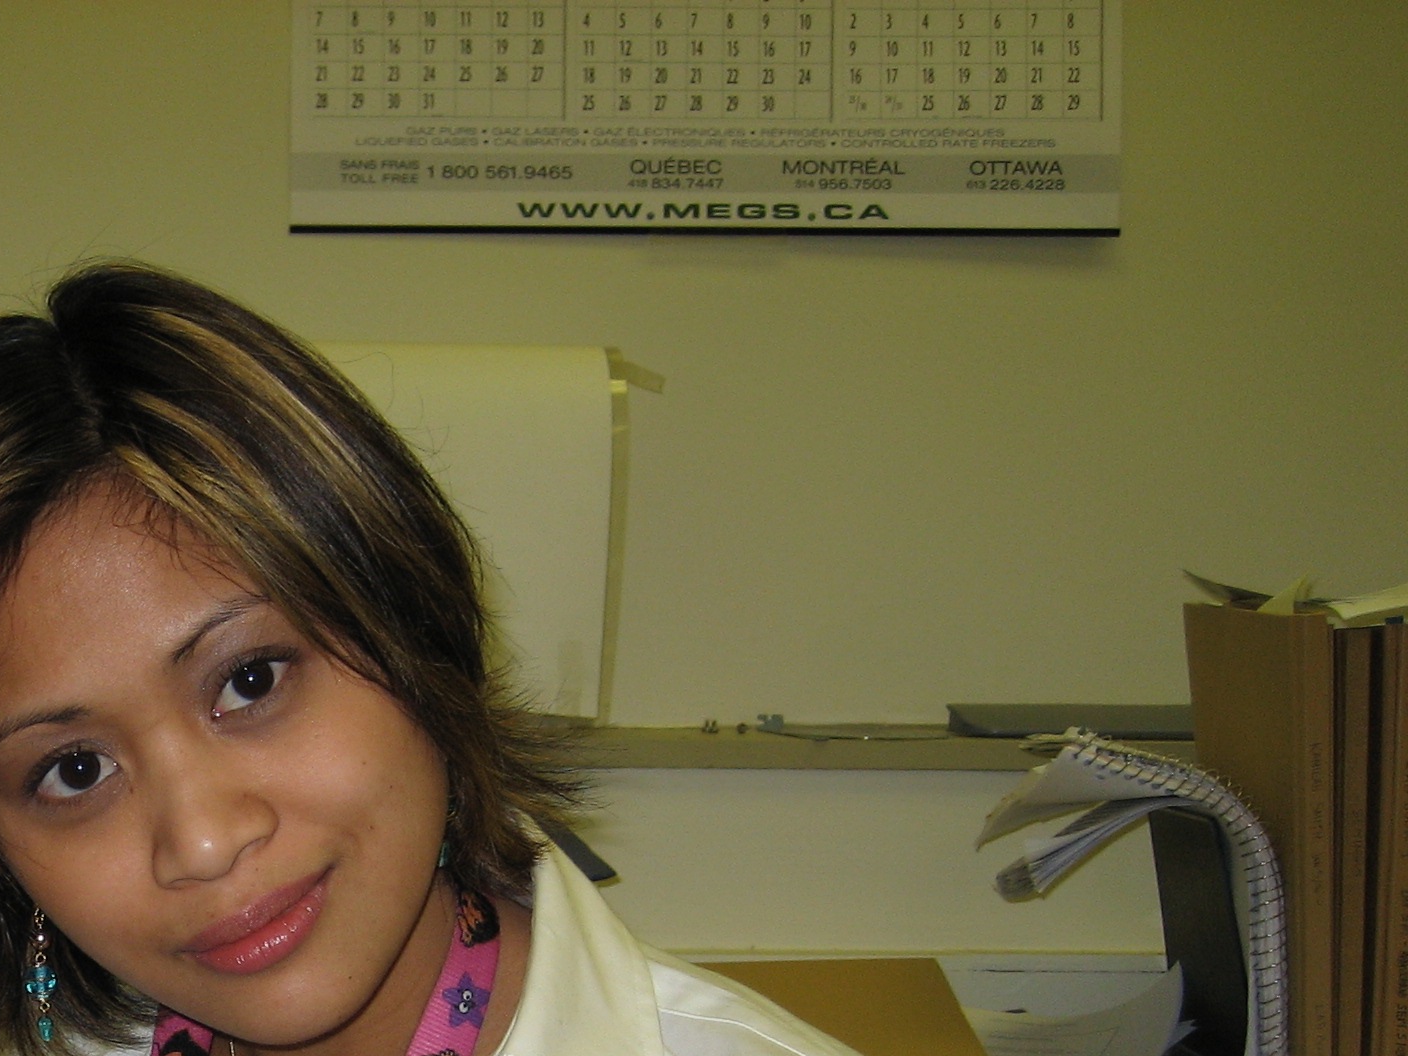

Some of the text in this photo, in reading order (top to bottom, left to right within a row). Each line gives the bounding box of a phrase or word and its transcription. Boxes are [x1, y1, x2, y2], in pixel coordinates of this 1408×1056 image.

[316, 12, 544, 27] 7 8 9 10 11 12 13
[583, 13, 811, 29] 4 5 6 7 8 9 10
[850, 14, 1074, 29] 2 3 4 5 6 7 8
[316, 39, 544, 54] 14 15 16 17 18 19 20
[583, 40, 811, 57] 11 12 13 14 15 16 17
[850, 40, 1079, 57] 9 10 11 12 13 14 15
[316, 67, 544, 82] 21 22 23 24 25 26 27
[583, 67, 811, 84] 18 19 20 21 22 23 24
[850, 68, 1079, 84] 16 17 18 19 20 21 22
[316, 93, 436, 108] 28 29 30 31
[583, 95, 775, 111] 25 26 27 28 29 30
[923, 95, 935, 111] 25
[959, 95, 971, 111] 26
[995, 95, 1007, 111] 27
[1031, 95, 1043, 111] 28
[1067, 95, 1079, 111] 29
[840, 139, 939, 148] CONTROLLED
[942, 139, 977, 148] RATE
[982, 139, 1057, 149] FREEZERS
[340, 160, 420, 170] SANS FRAIS
[426, 165, 574, 180] 1 800 561.9465
[629, 157, 723, 175] QUÉBEC
[781, 158, 906, 176] MONTRÉAL
[968, 160, 1064, 176] OTTAWA
[340, 173, 419, 184] TOLL FREE
[651, 178, 725, 190] 834.7447
[818, 178, 893, 190] 956.7503
[989, 179, 1066, 191] 226.4228
[517, 202, 890, 220] WWW.MEGS.CA
